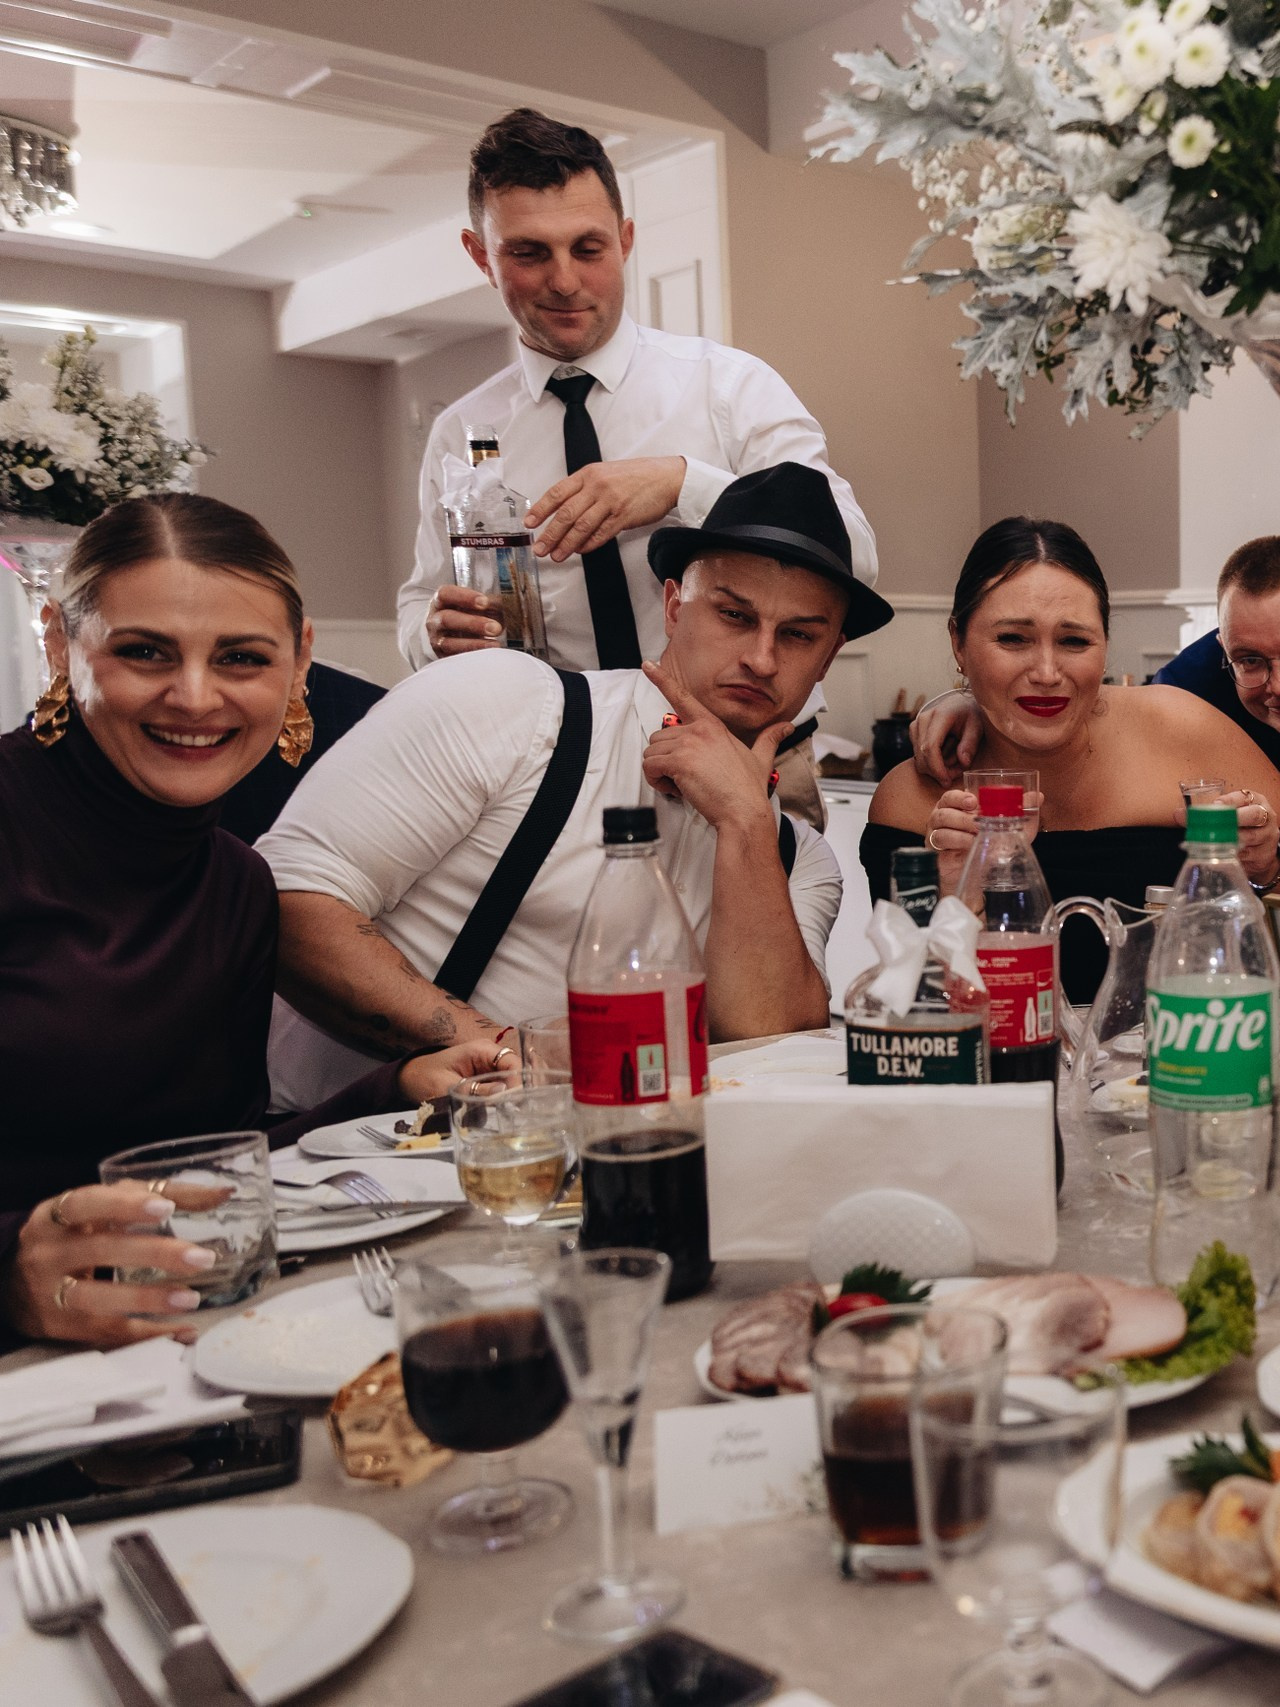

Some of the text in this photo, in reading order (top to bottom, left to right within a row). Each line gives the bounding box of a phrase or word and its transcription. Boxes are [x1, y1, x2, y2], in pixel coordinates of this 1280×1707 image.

[460, 537, 505, 546] STUMBRAS
[850, 1032, 959, 1057] TULLAMORE
[876, 1056, 925, 1078] D.E.W.
